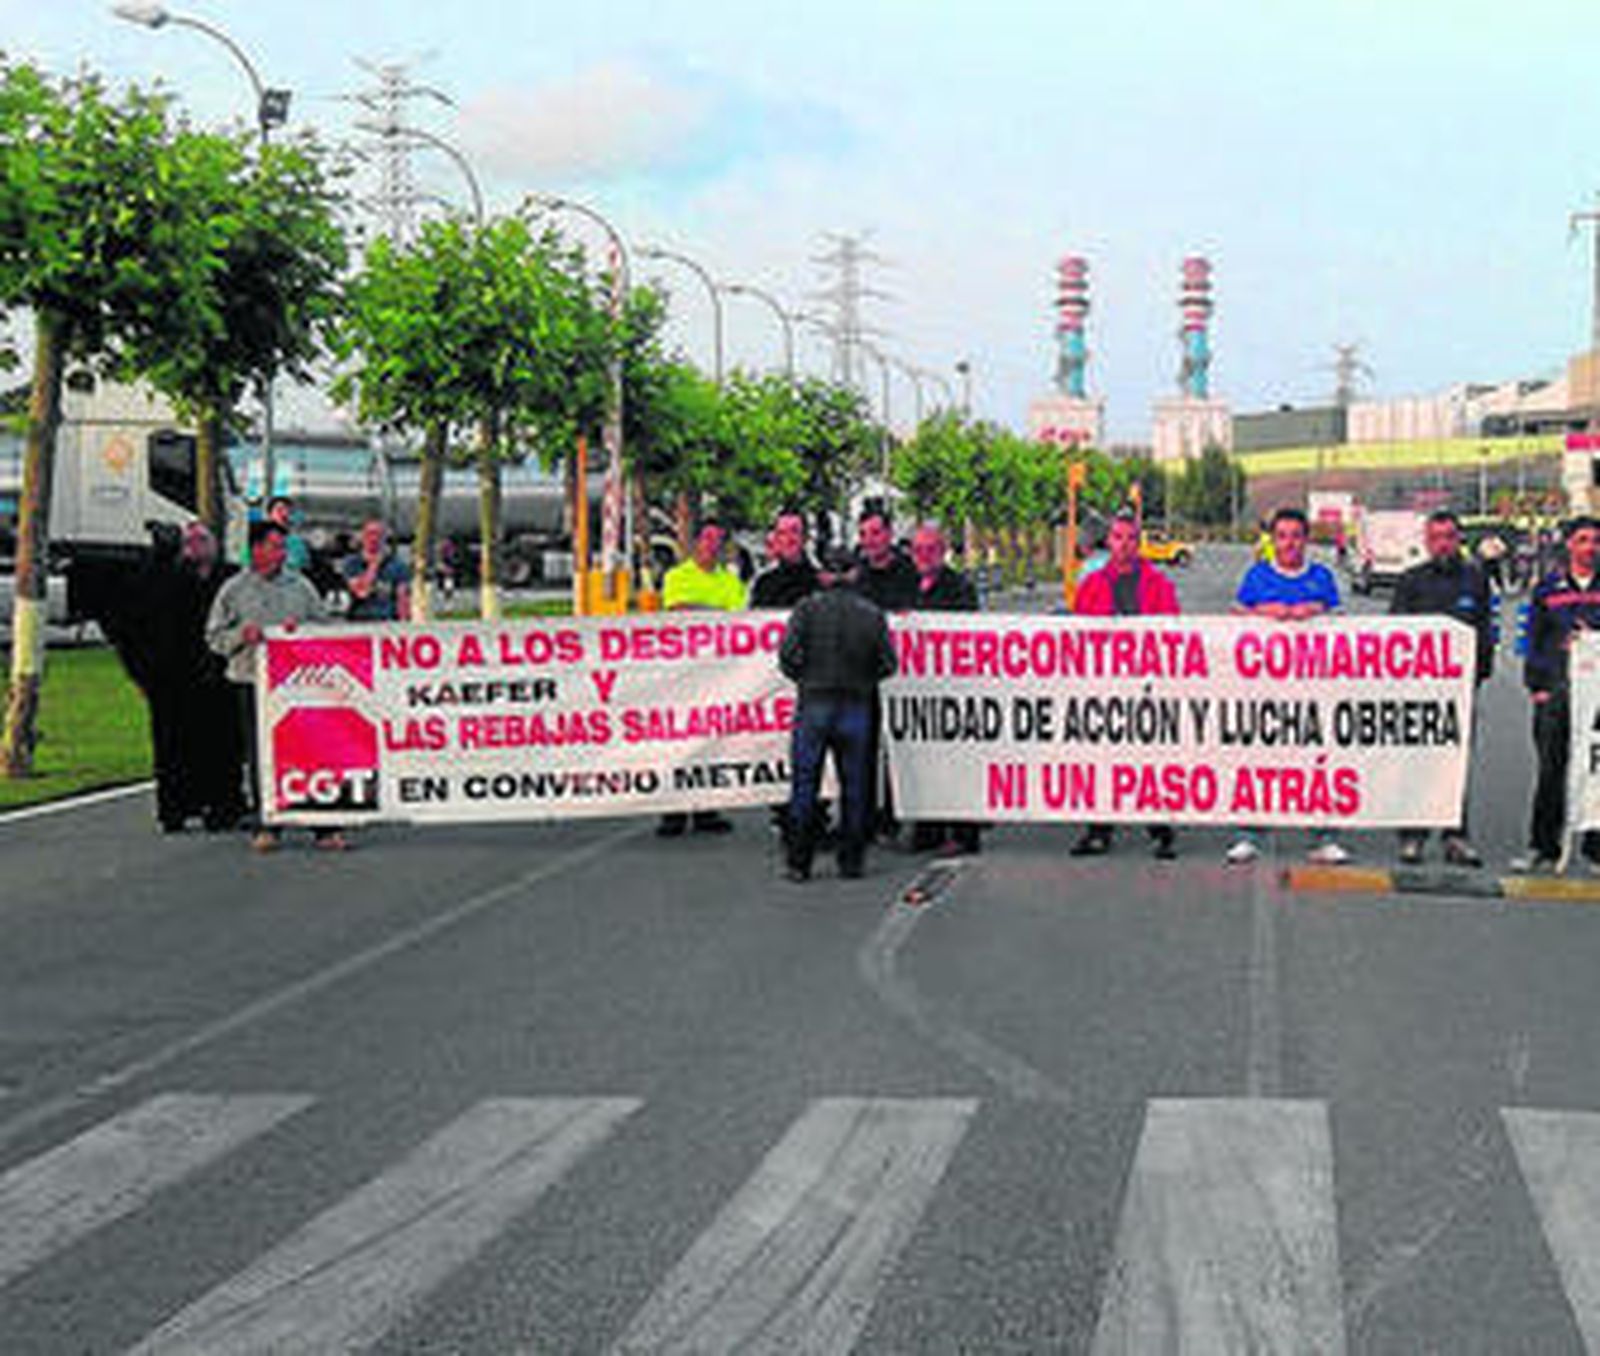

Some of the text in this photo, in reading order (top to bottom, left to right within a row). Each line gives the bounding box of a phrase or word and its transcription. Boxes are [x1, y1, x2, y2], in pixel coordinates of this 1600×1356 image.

[380, 635, 441, 670] NO
[457, 636, 488, 668] A
[500, 629, 584, 667] LOS
[1234, 632, 1463, 680] COMARCAL
[408, 679, 557, 707] KAEFER
[592, 671, 616, 703] Y
[382, 718, 447, 752] LAS
[458, 707, 614, 749] REBAJAS
[888, 683, 1460, 746] UNIDAD DE ACCIÓN Y LUCHA OBRERA
[281, 769, 373, 803] CGT
[400, 761, 794, 801] EN CONVENIO METAL
[988, 755, 1360, 815] NI UN PASO ATRÁS
